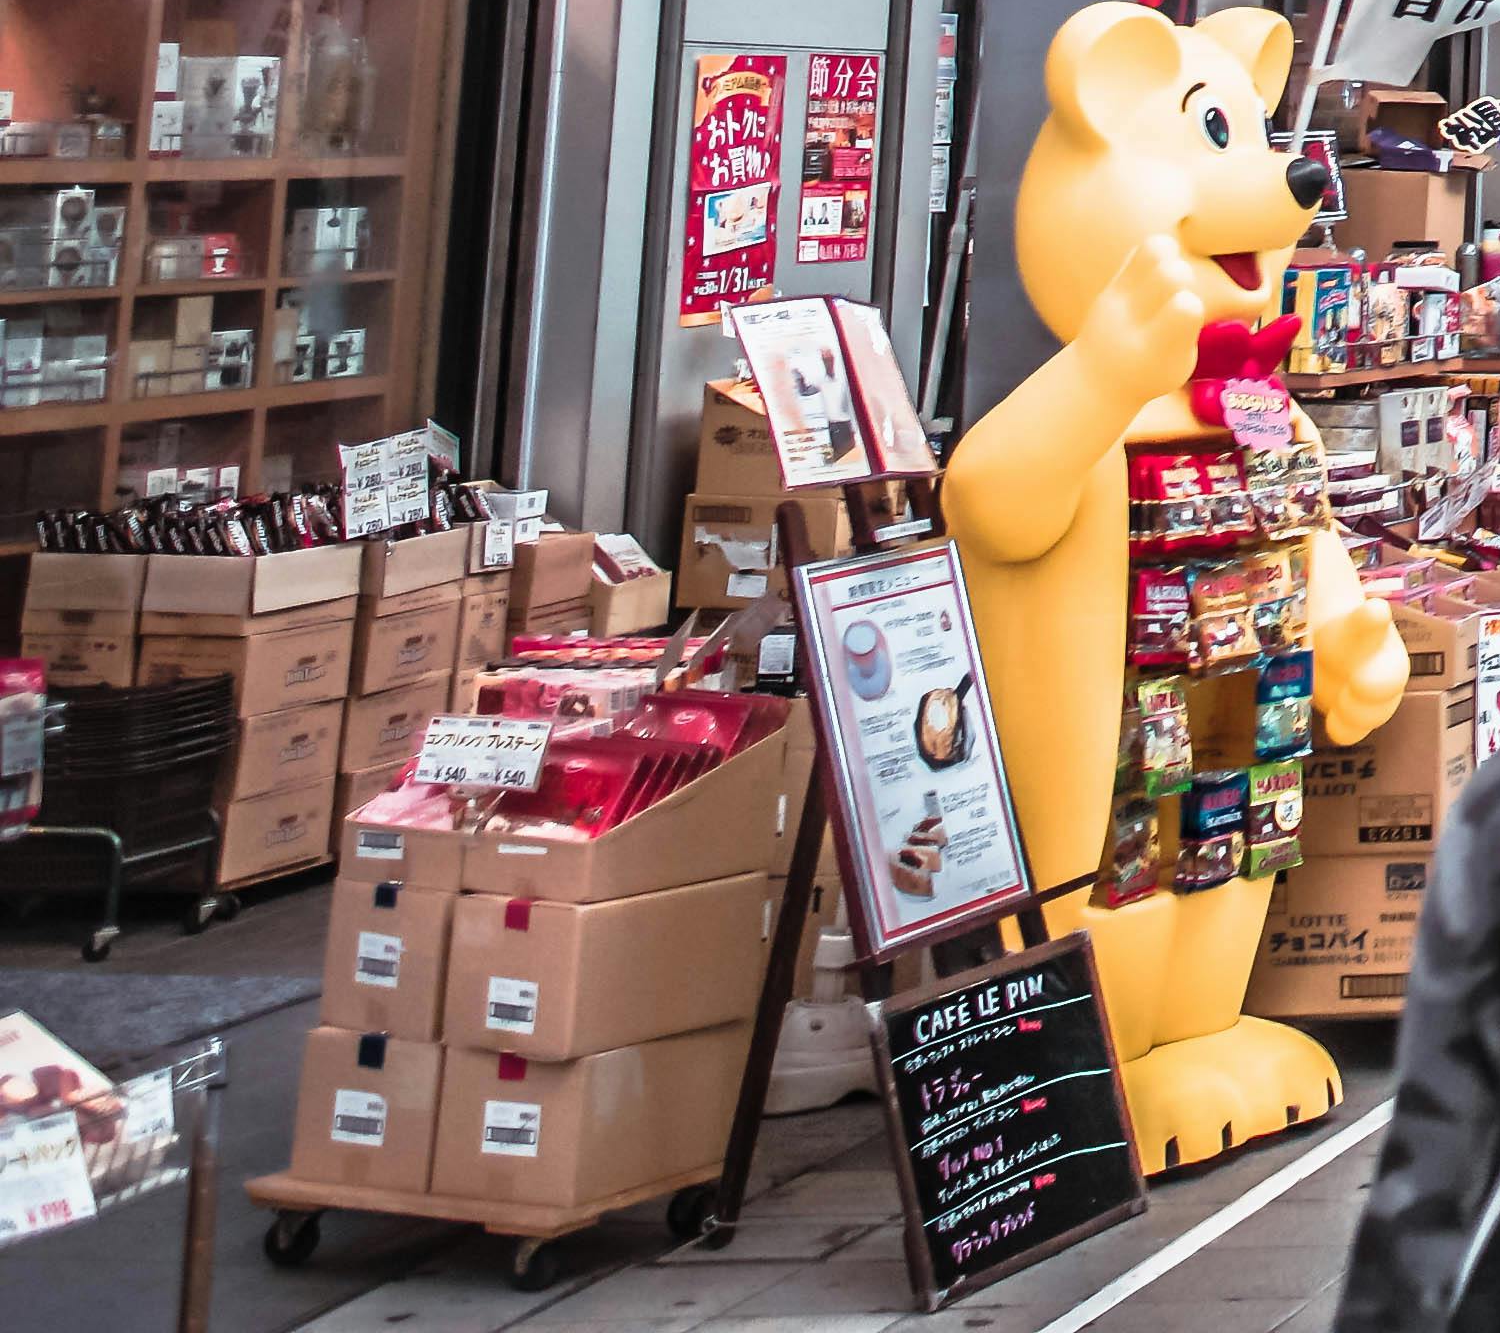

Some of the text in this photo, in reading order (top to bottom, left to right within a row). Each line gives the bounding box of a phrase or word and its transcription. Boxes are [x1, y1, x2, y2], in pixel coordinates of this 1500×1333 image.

[809, 55, 878, 98] 節分会
[706, 108, 767, 150] おトクに
[1269, 928, 1370, 953] チョコパイ
[1289, 914, 1348, 928] LOTTE
[914, 973, 1044, 1044] CAFÉ LE PIN
